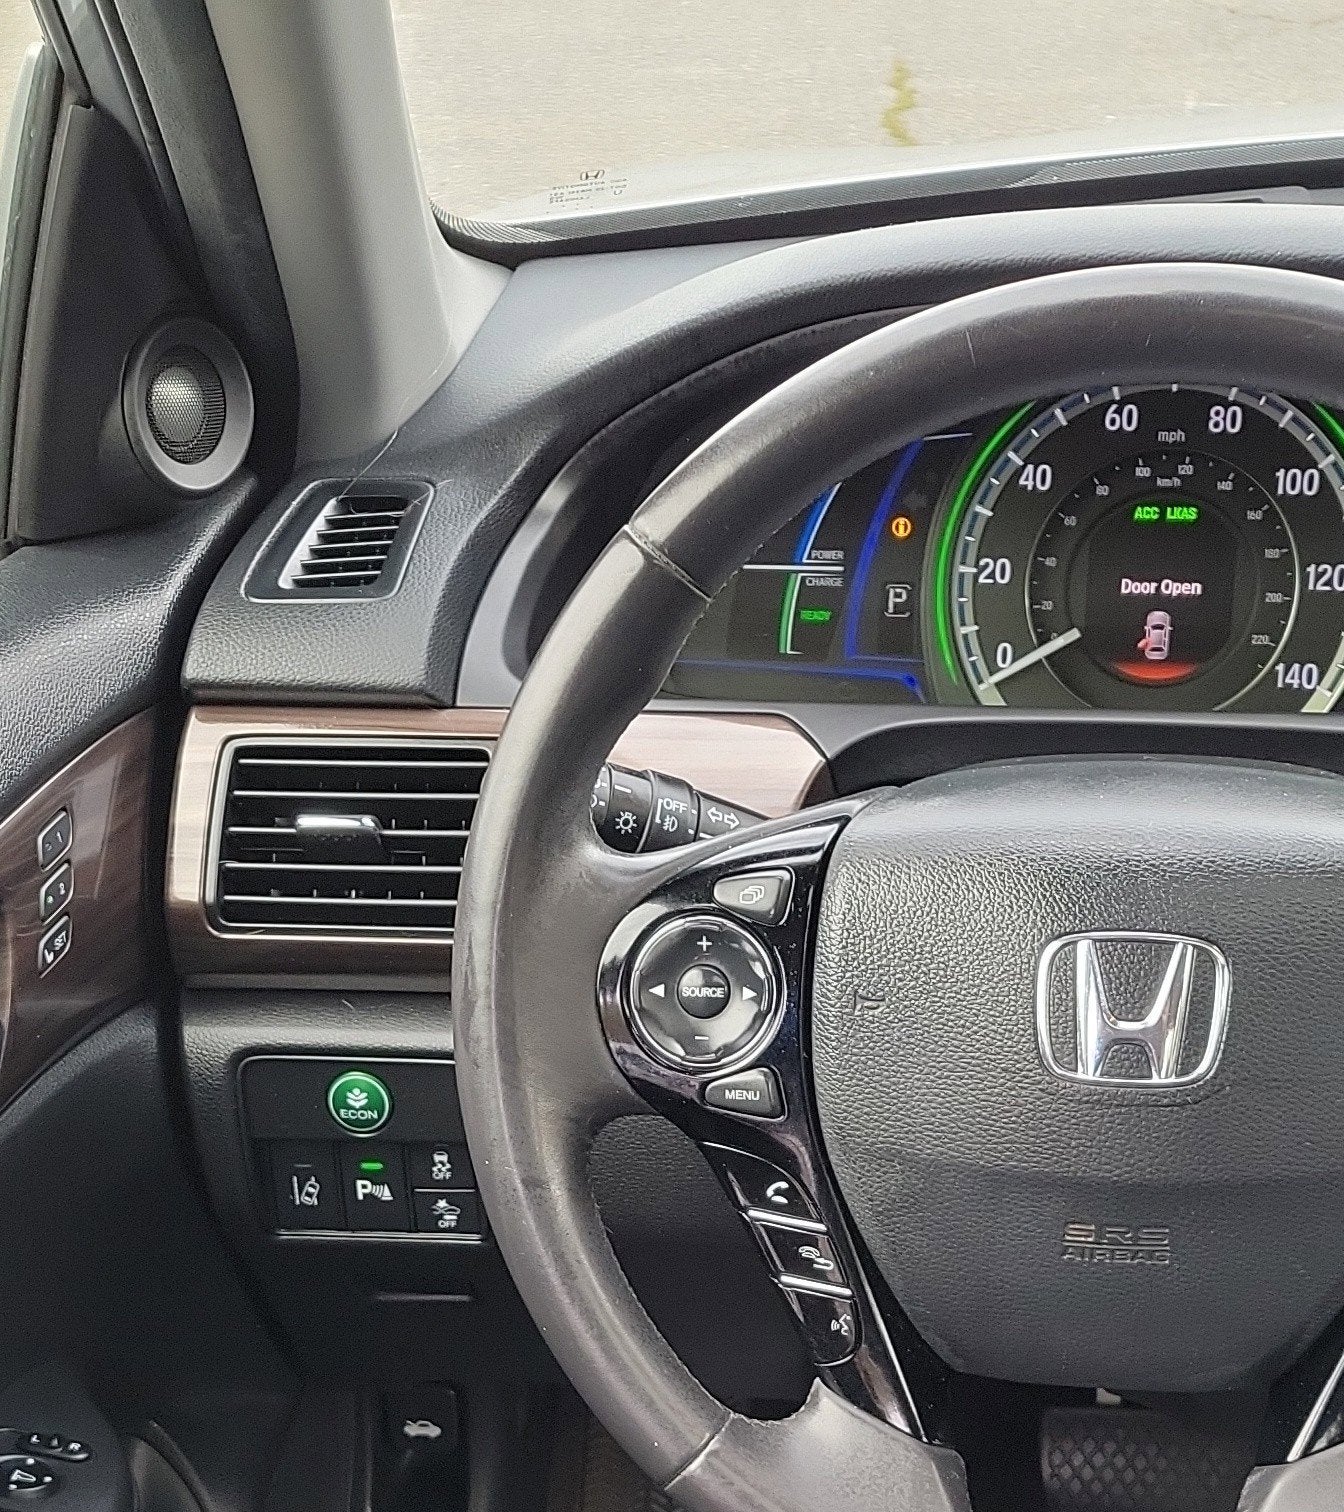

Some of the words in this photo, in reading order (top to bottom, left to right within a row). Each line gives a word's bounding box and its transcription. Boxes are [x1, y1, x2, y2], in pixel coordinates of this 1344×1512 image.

[1104, 403, 1139, 431] 60
[1207, 405, 1243, 434] 80
[1157, 429, 1186, 444] mph
[1018, 464, 1053, 491] 40
[1156, 476, 1182, 487] km/h
[1275, 468, 1321, 496] 100
[1133, 507, 1160, 520] ACC
[811, 550, 845, 560] POWER
[977, 558, 1012, 584] 20
[806, 577, 845, 587] CHARGE
[1120, 578, 1159, 595] Door
[1161, 579, 1203, 597] Open
[887, 588, 908, 614] P
[996, 641, 1013, 669] 0
[1274, 662, 1320, 690] 140
[663, 798, 689, 814] OFF
[681, 985, 725, 999] SOURCE
[725, 1088, 760, 1101] MENU
[339, 1108, 379, 1120] ECON
[1064, 1222, 1169, 1245] SRS
